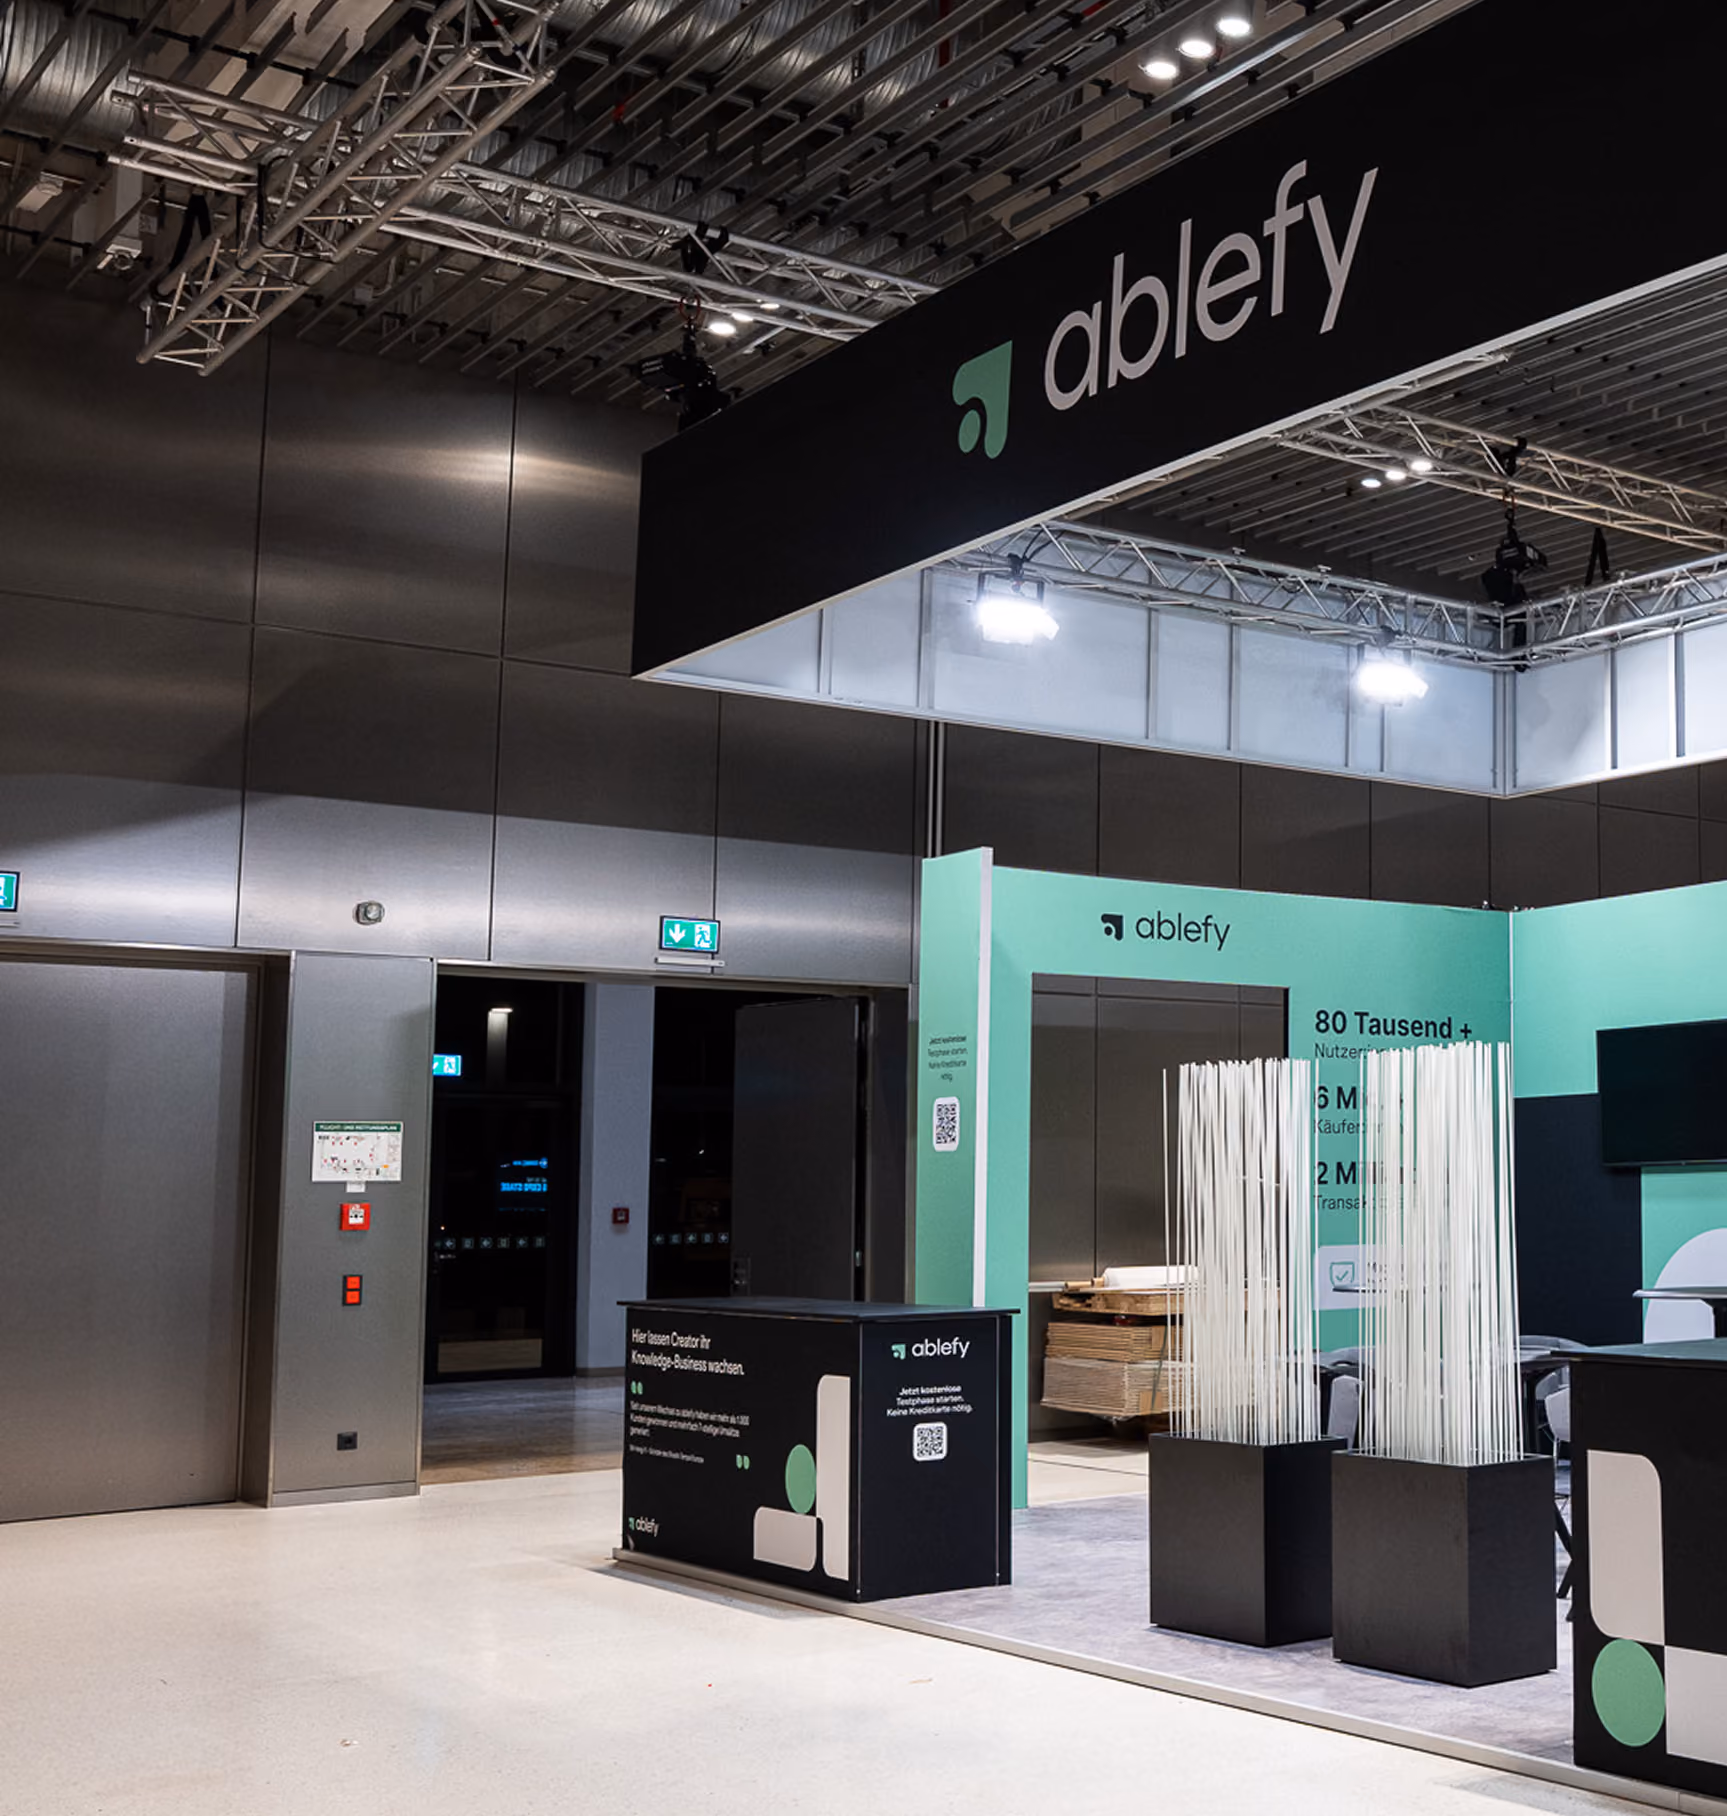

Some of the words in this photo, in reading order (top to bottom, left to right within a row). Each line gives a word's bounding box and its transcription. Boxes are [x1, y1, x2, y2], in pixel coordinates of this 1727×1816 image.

[1044, 160, 1379, 411] ablefy
[1136, 910, 1230, 951] ablefy
[1315, 1009, 1347, 1034] 80
[1354, 1011, 1452, 1039] Tausend
[1314, 1161, 1329, 1184] 2
[632, 1328, 646, 1343] Hier
[647, 1330, 670, 1346] lassen
[671, 1331, 699, 1349] Creator
[700, 1334, 712, 1349] ihr
[911, 1336, 970, 1358] ablefy
[631, 1349, 708, 1372] Knowledge-Business
[708, 1358, 745, 1376] wachsen.
[635, 1516, 660, 1538] ablefy
